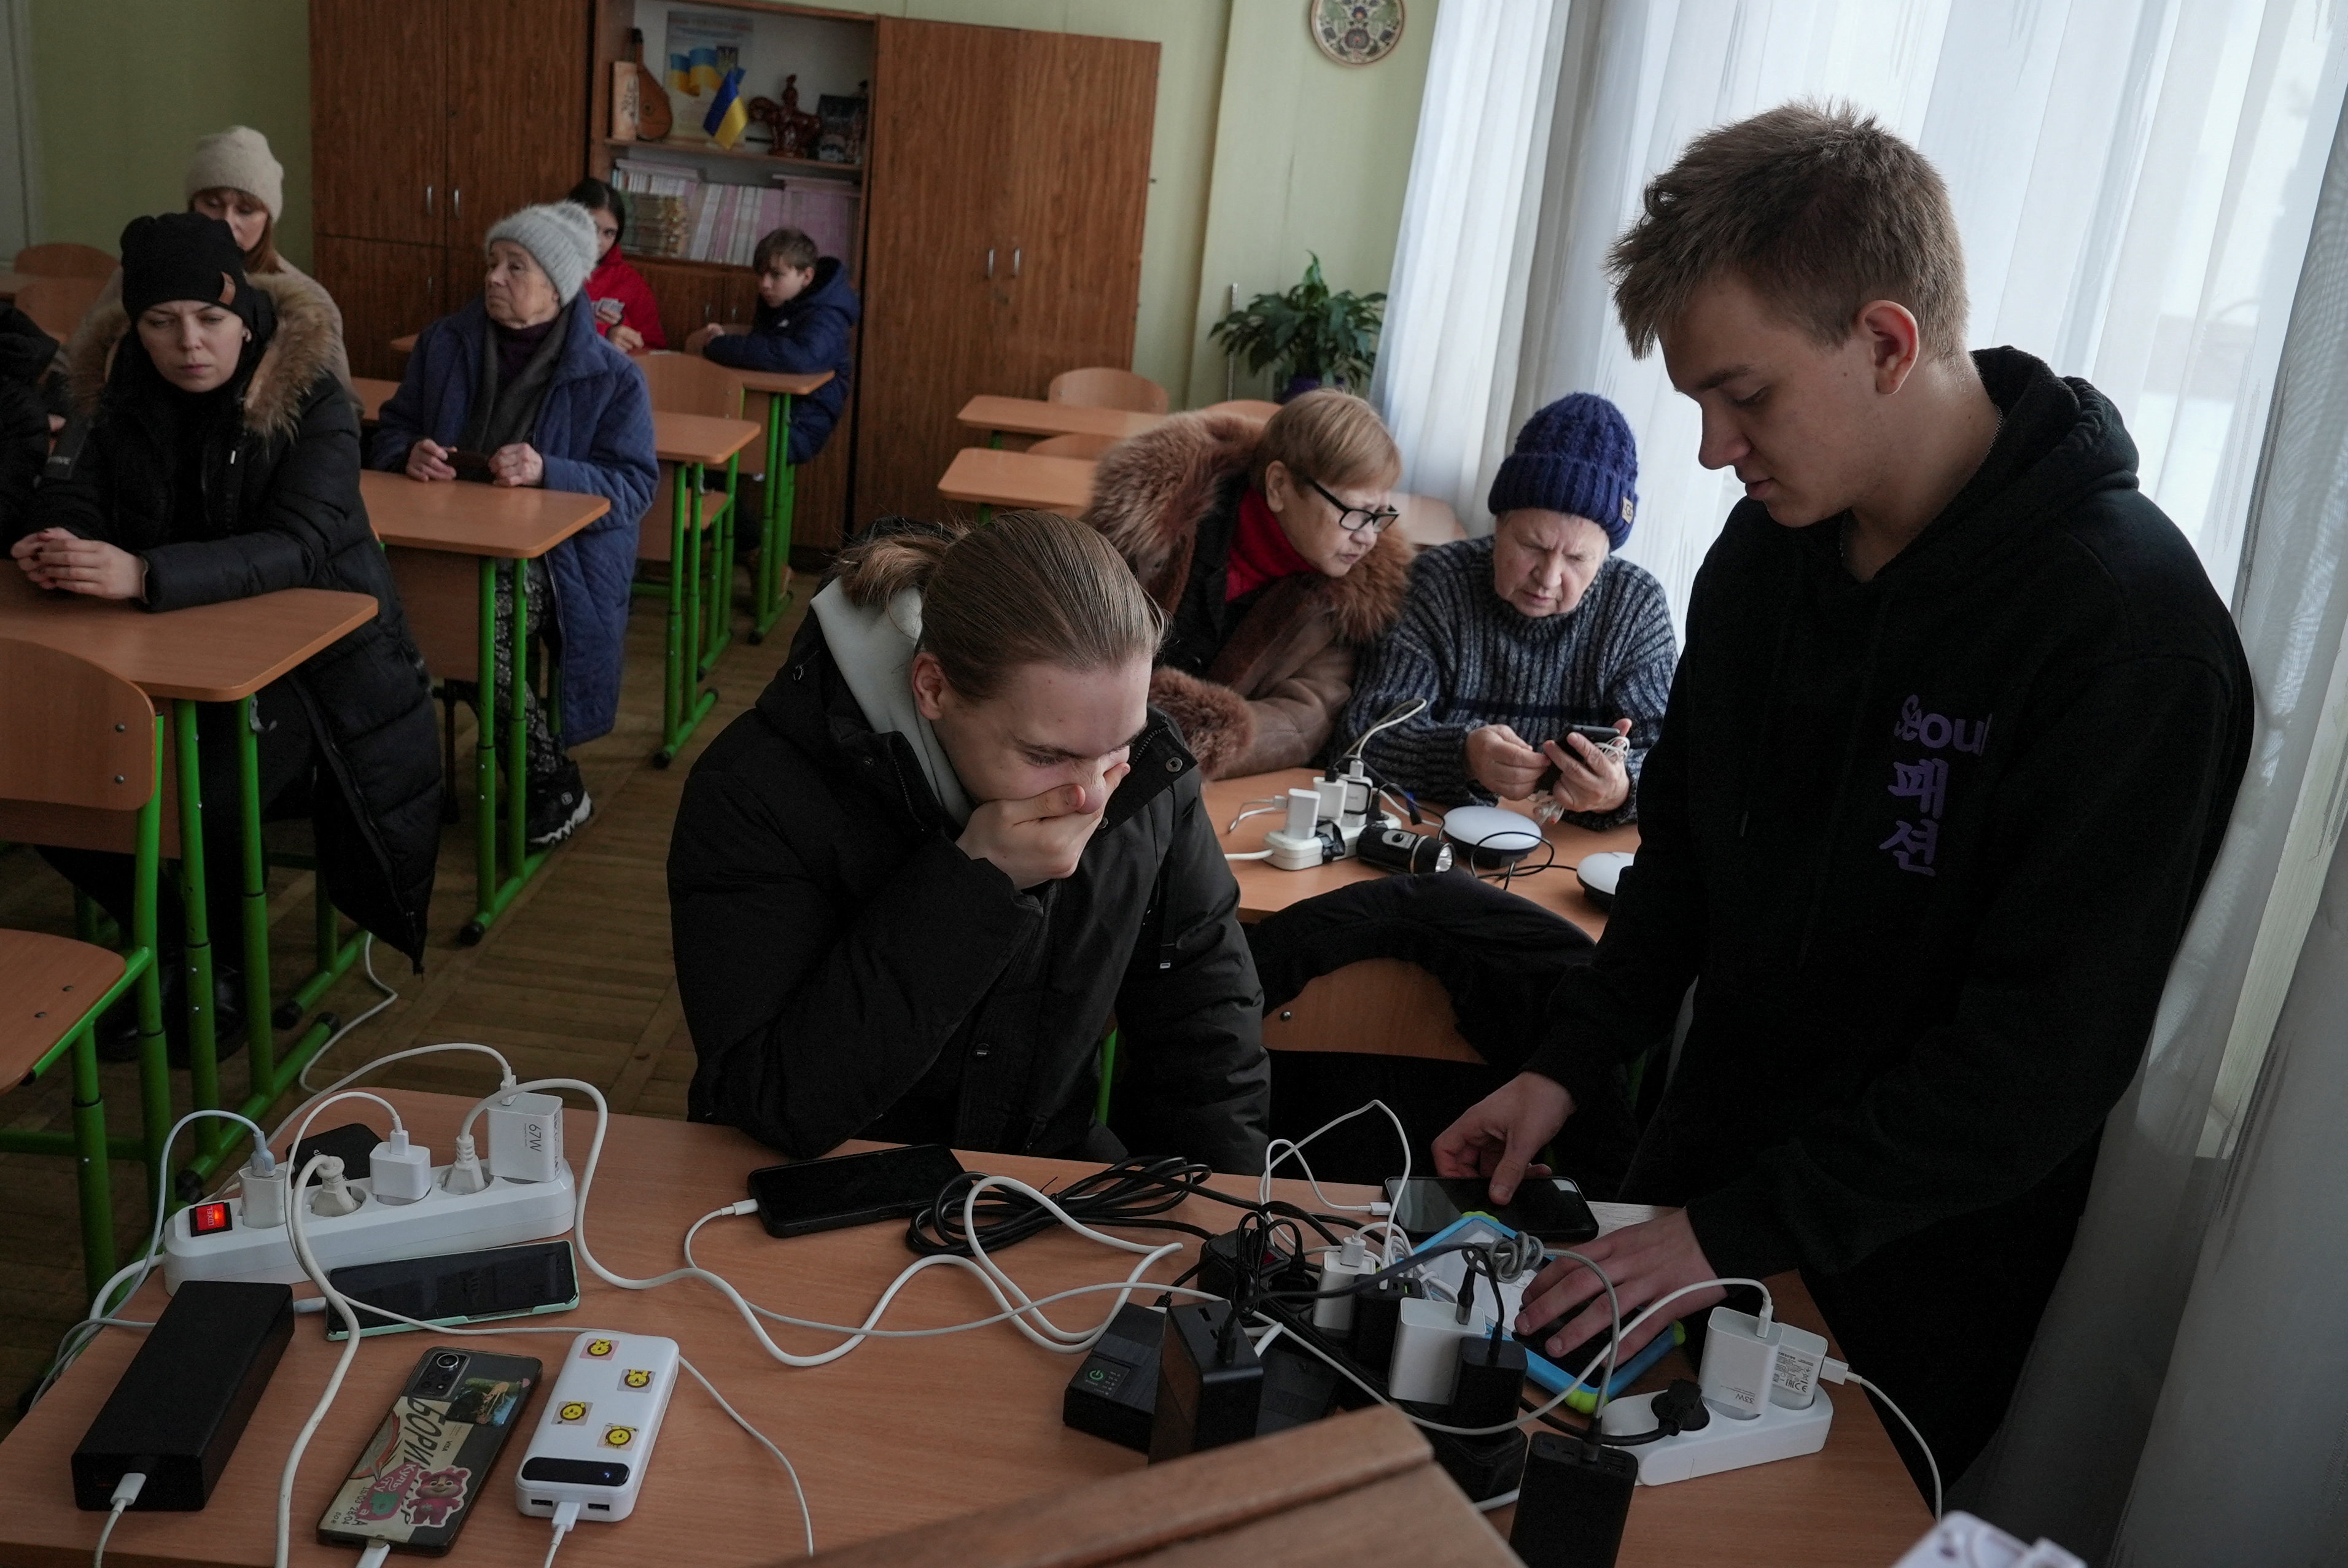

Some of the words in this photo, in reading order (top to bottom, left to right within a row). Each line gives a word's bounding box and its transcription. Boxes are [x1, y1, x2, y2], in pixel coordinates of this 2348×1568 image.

[1879, 758, 1949, 877] 패션
[529, 1124, 542, 1152] 67W
[1735, 1393, 1755, 1405] 33W
[441, 1440, 453, 1452] VISA
